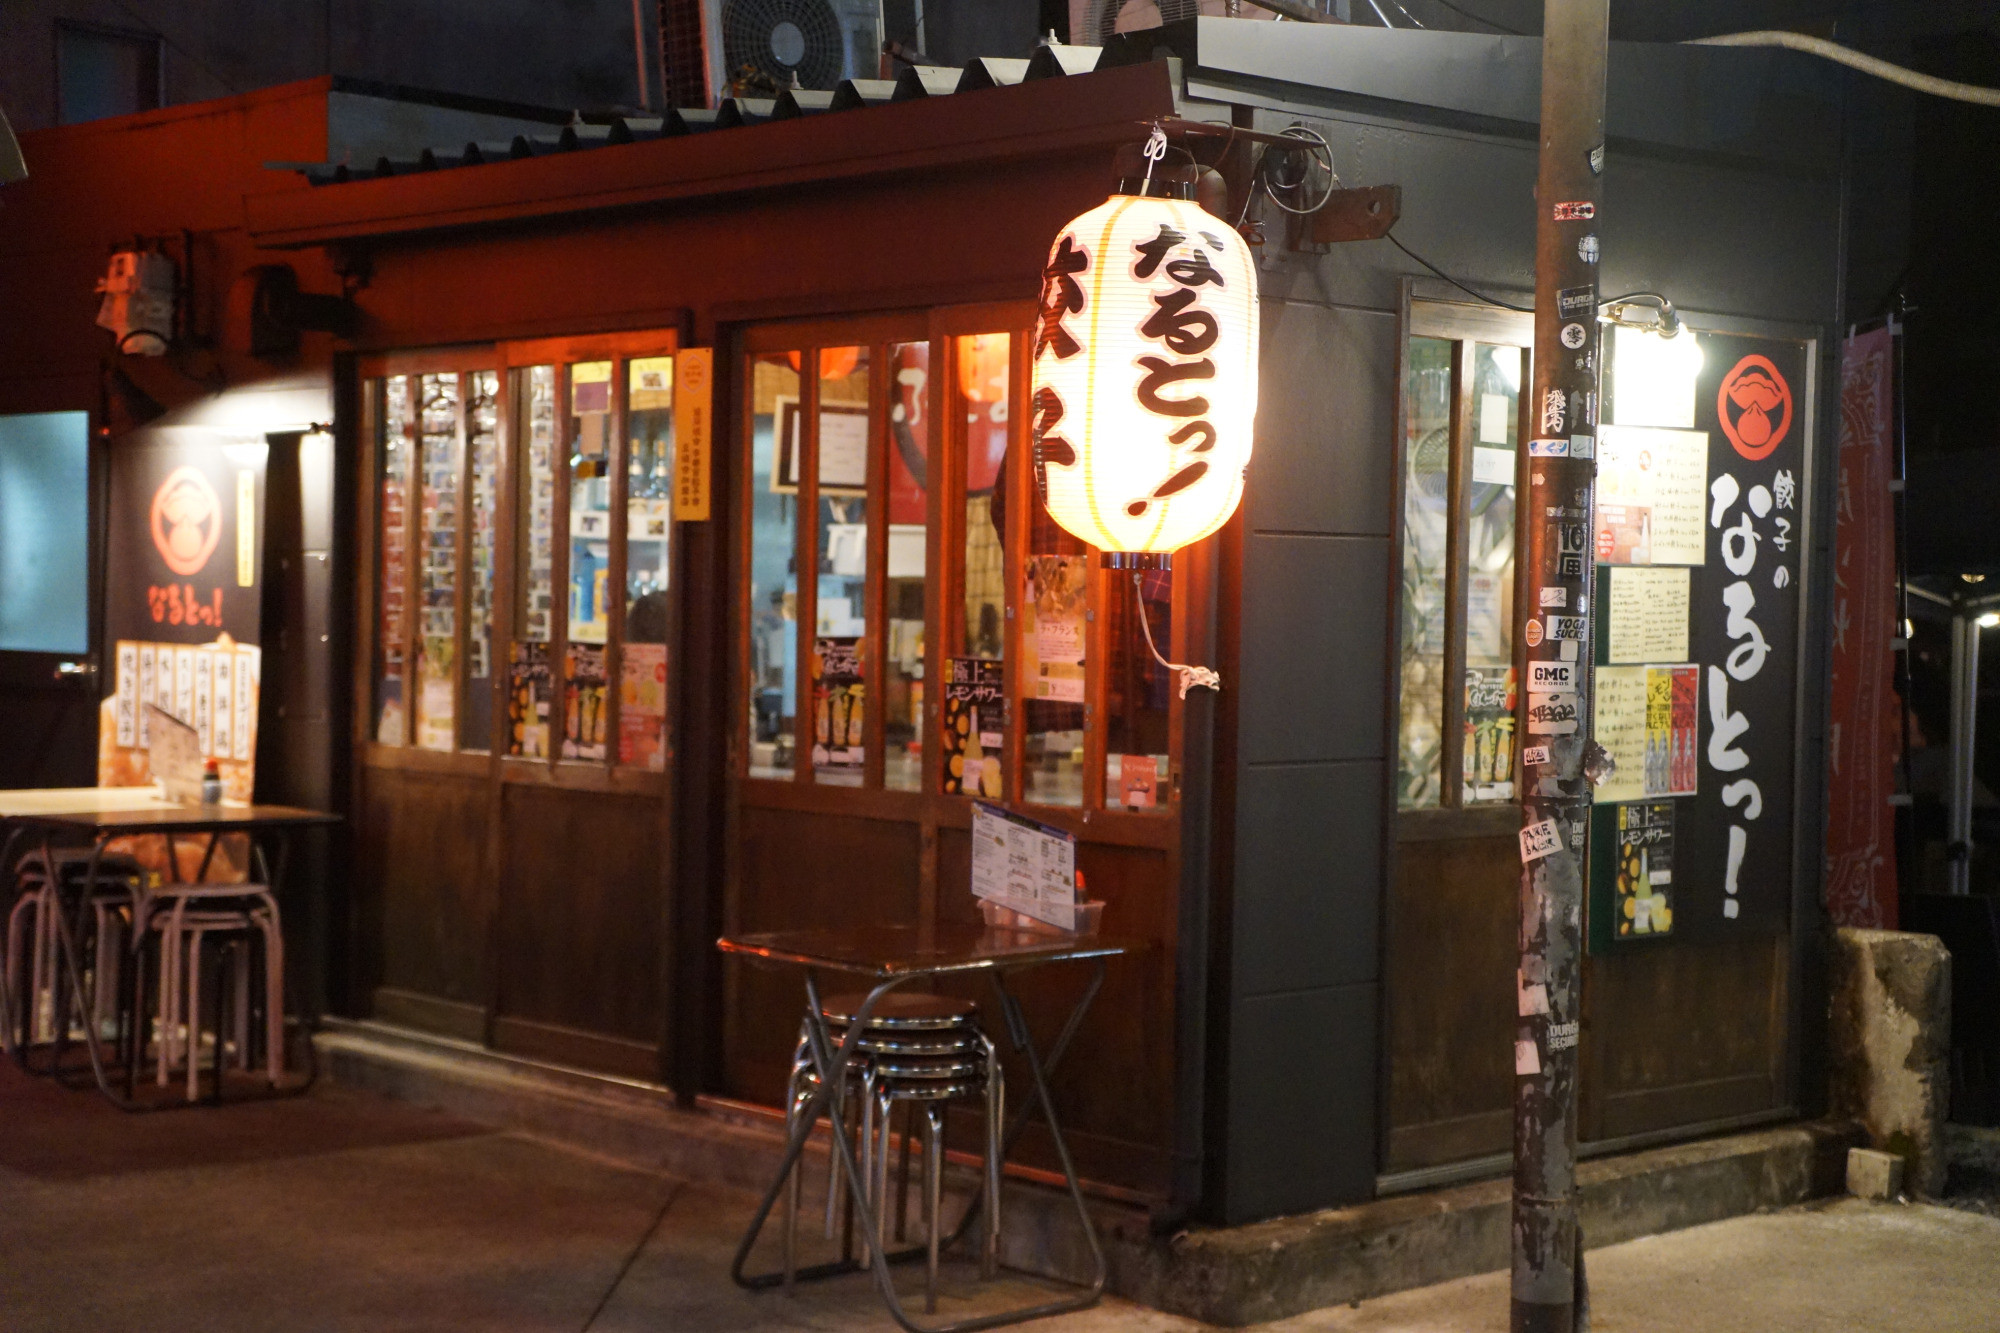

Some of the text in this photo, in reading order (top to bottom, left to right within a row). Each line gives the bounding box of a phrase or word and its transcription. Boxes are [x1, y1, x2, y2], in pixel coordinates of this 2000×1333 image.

[1127, 223, 1226, 517] なるとっ!
[1773, 468, 1796, 590] 餃子の
[1553, 629, 1585, 640] SUCKS
[1557, 618, 1586, 631] YOGA
[1534, 667, 1569, 681] GMC
[1707, 472, 1773, 920] なるとっ!
[1627, 805, 1654, 829] 極上
[1619, 828, 1672, 846] レモンサワー
